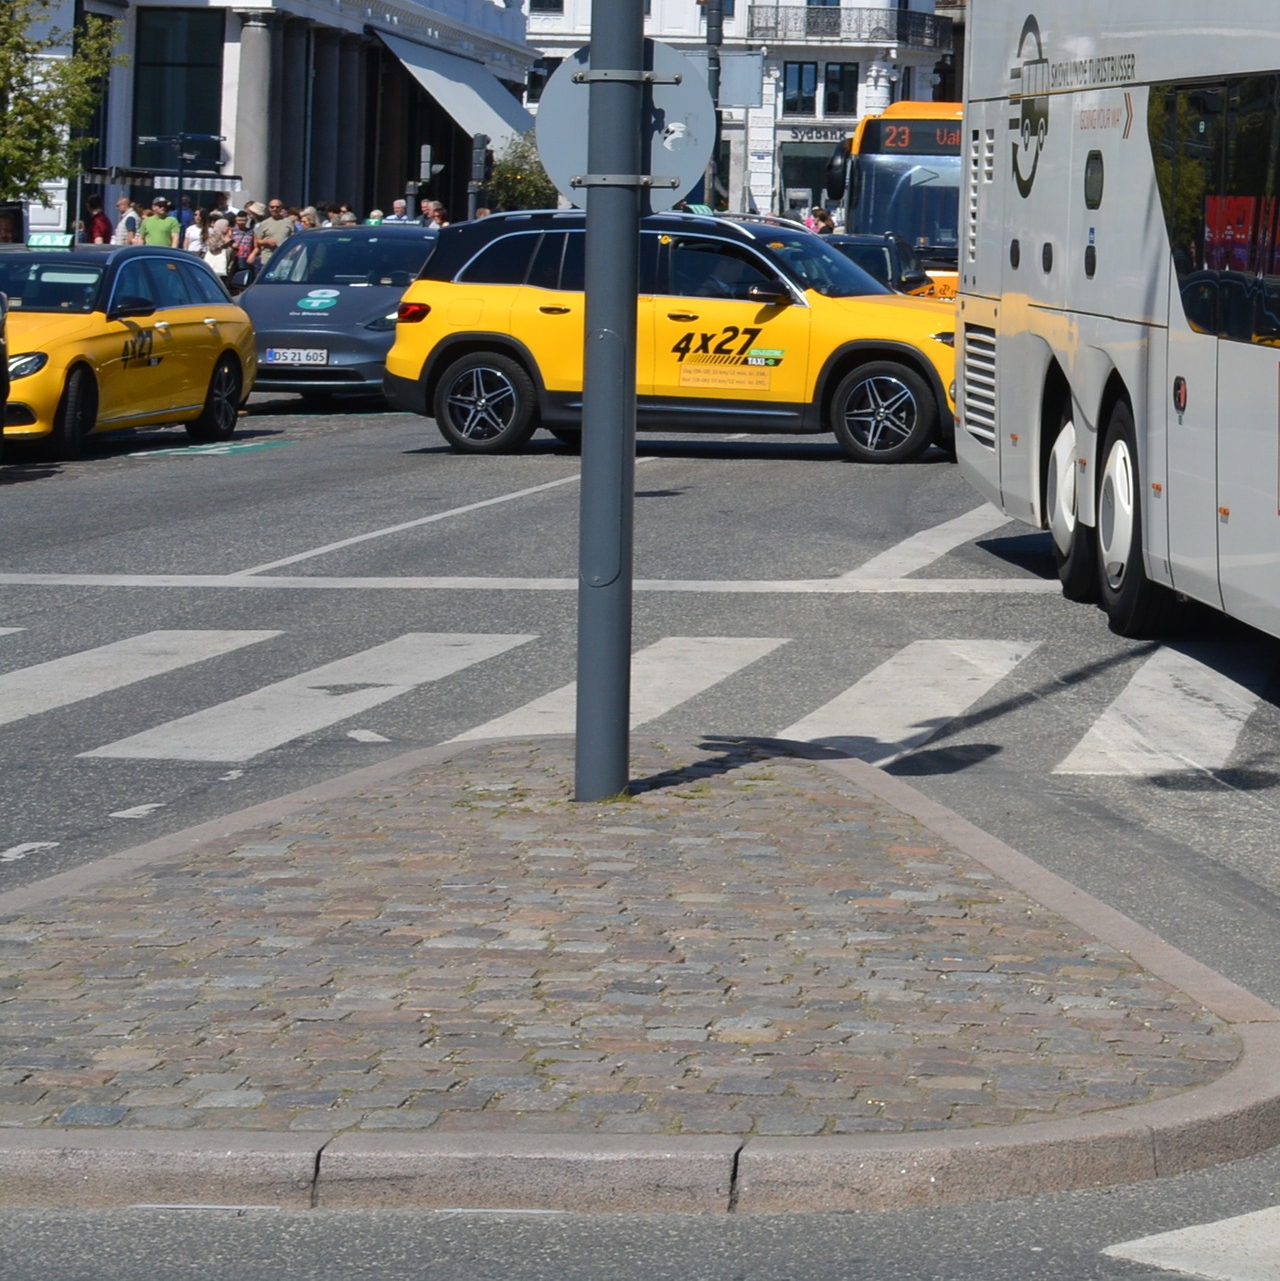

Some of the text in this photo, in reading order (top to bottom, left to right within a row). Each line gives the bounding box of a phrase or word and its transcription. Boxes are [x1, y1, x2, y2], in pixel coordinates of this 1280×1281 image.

[791, 127, 846, 141] Sydbank
[885, 126, 911, 147] 23
[30, 234, 73, 246] TAXI
[275, 352, 325, 361] DS 21 605
[747, 357, 765, 366] TAXI
